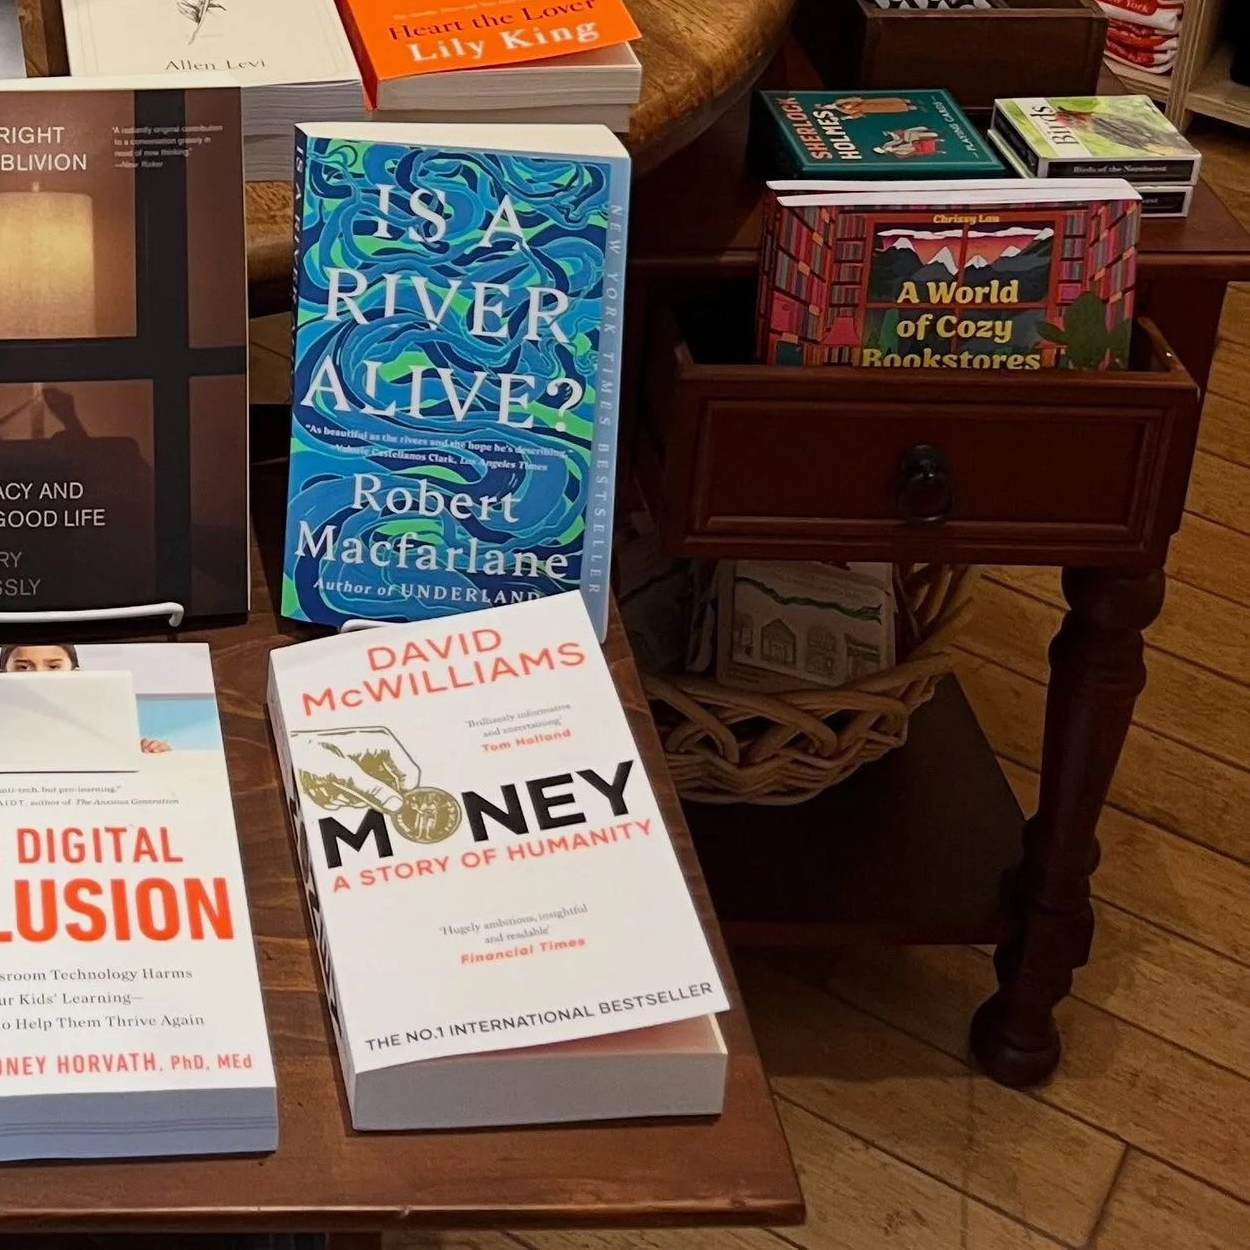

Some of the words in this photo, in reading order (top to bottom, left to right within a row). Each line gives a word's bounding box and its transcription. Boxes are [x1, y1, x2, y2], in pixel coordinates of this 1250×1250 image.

[389, 20, 464, 40] Heart
[473, 11, 514, 29] the
[408, 37, 486, 62] Lily
[500, 21, 599, 50] King
[165, 59, 216, 71] Allen
[226, 59, 266, 70] Levi
[776, 97, 833, 159] SHERLOCK
[813, 109, 862, 160] HOLMES
[1030, 105, 1079, 145] Birds
[372, 183, 447, 243] IS
[477, 194, 531, 251] A
[323, 267, 571, 343] RIVER
[897, 282, 919, 304] A
[928, 279, 1018, 304] World
[897, 314, 933, 338] of
[936, 316, 1012, 344] Cozy
[862, 349, 1041, 370] Bookstores
[300, 355, 584, 432] ALIVE?
[351, 473, 519, 523] Robert
[294, 520, 568, 580] Macfarlane
[367, 627, 502, 672] DAVID
[302, 642, 586, 718] McWILLIAMS
[17, 826, 183, 864] DIGITAL
